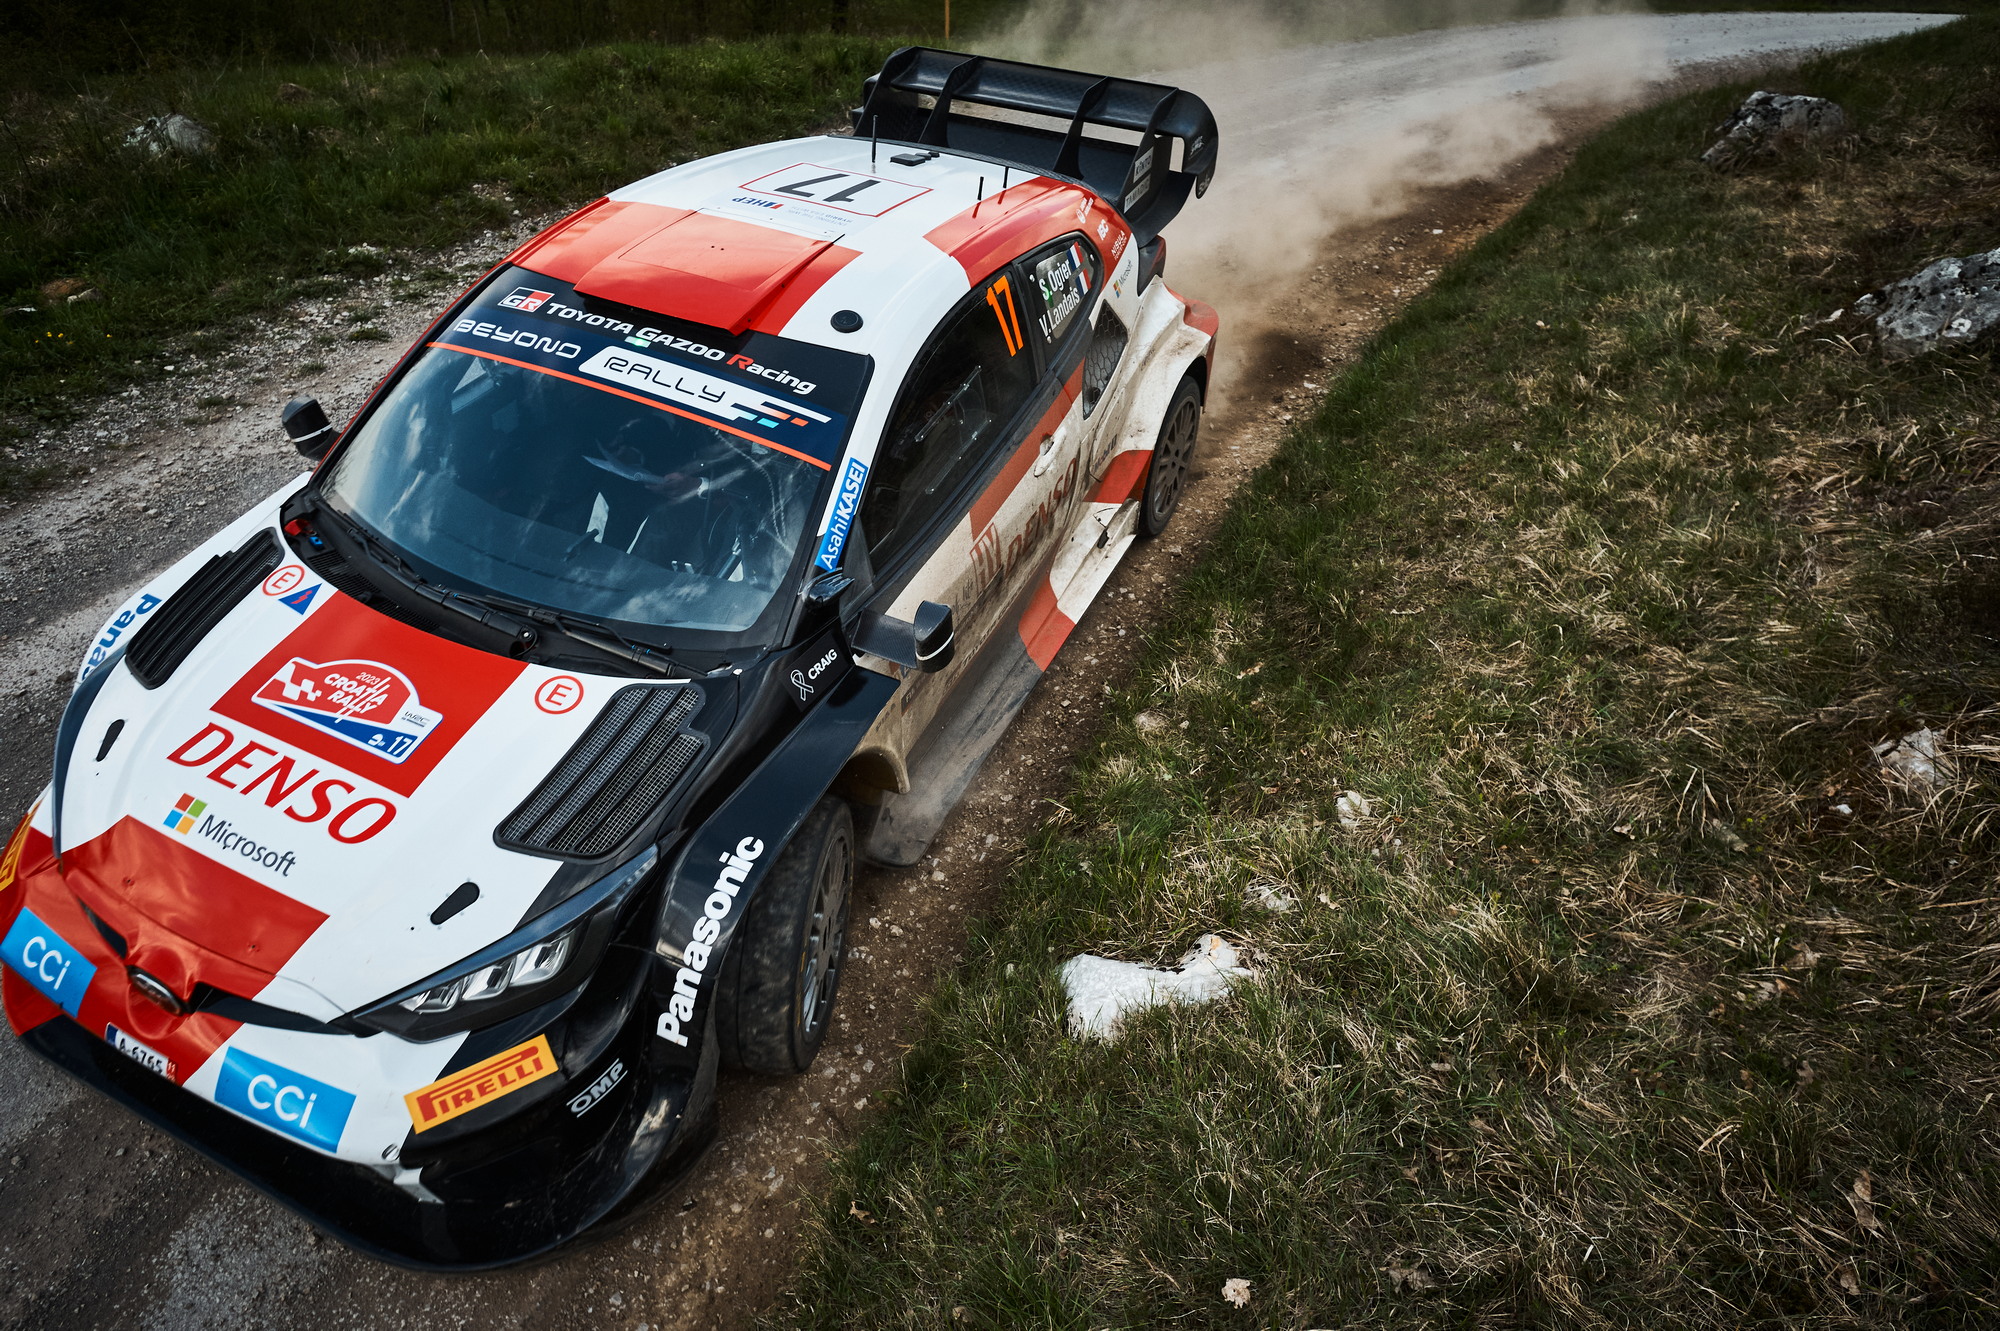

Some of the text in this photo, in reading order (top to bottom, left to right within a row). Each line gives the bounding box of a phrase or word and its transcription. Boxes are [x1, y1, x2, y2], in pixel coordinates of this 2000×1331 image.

[732, 197, 768, 208] HEP
[773, 173, 881, 203] 17
[1039, 259, 1072, 301] S.Ogier
[985, 275, 1024, 357] 17
[1038, 286, 1080, 338] V.Landais
[453, 318, 582, 360] BEYOND
[502, 293, 817, 395] GR TOYOTA GAZOO Racing
[603, 357, 727, 403] RALLY
[820, 461, 866, 570] AsahiKASEI
[323, 673, 389, 705] CROATIA
[355, 671, 381, 685] 2023
[807, 648, 838, 681] CRAIG
[327, 690, 378, 714] RALLY
[387, 736, 413, 756] 17
[166, 721, 397, 845] DENSO
[198, 814, 297, 877] Microsoft
[22, 936, 71, 990] CCi
[656, 836, 765, 1047] Panasonic
[247, 1073, 317, 1128] CCi
[416, 1044, 545, 1123] PIRELLI
[570, 1061, 624, 1113] OMP
